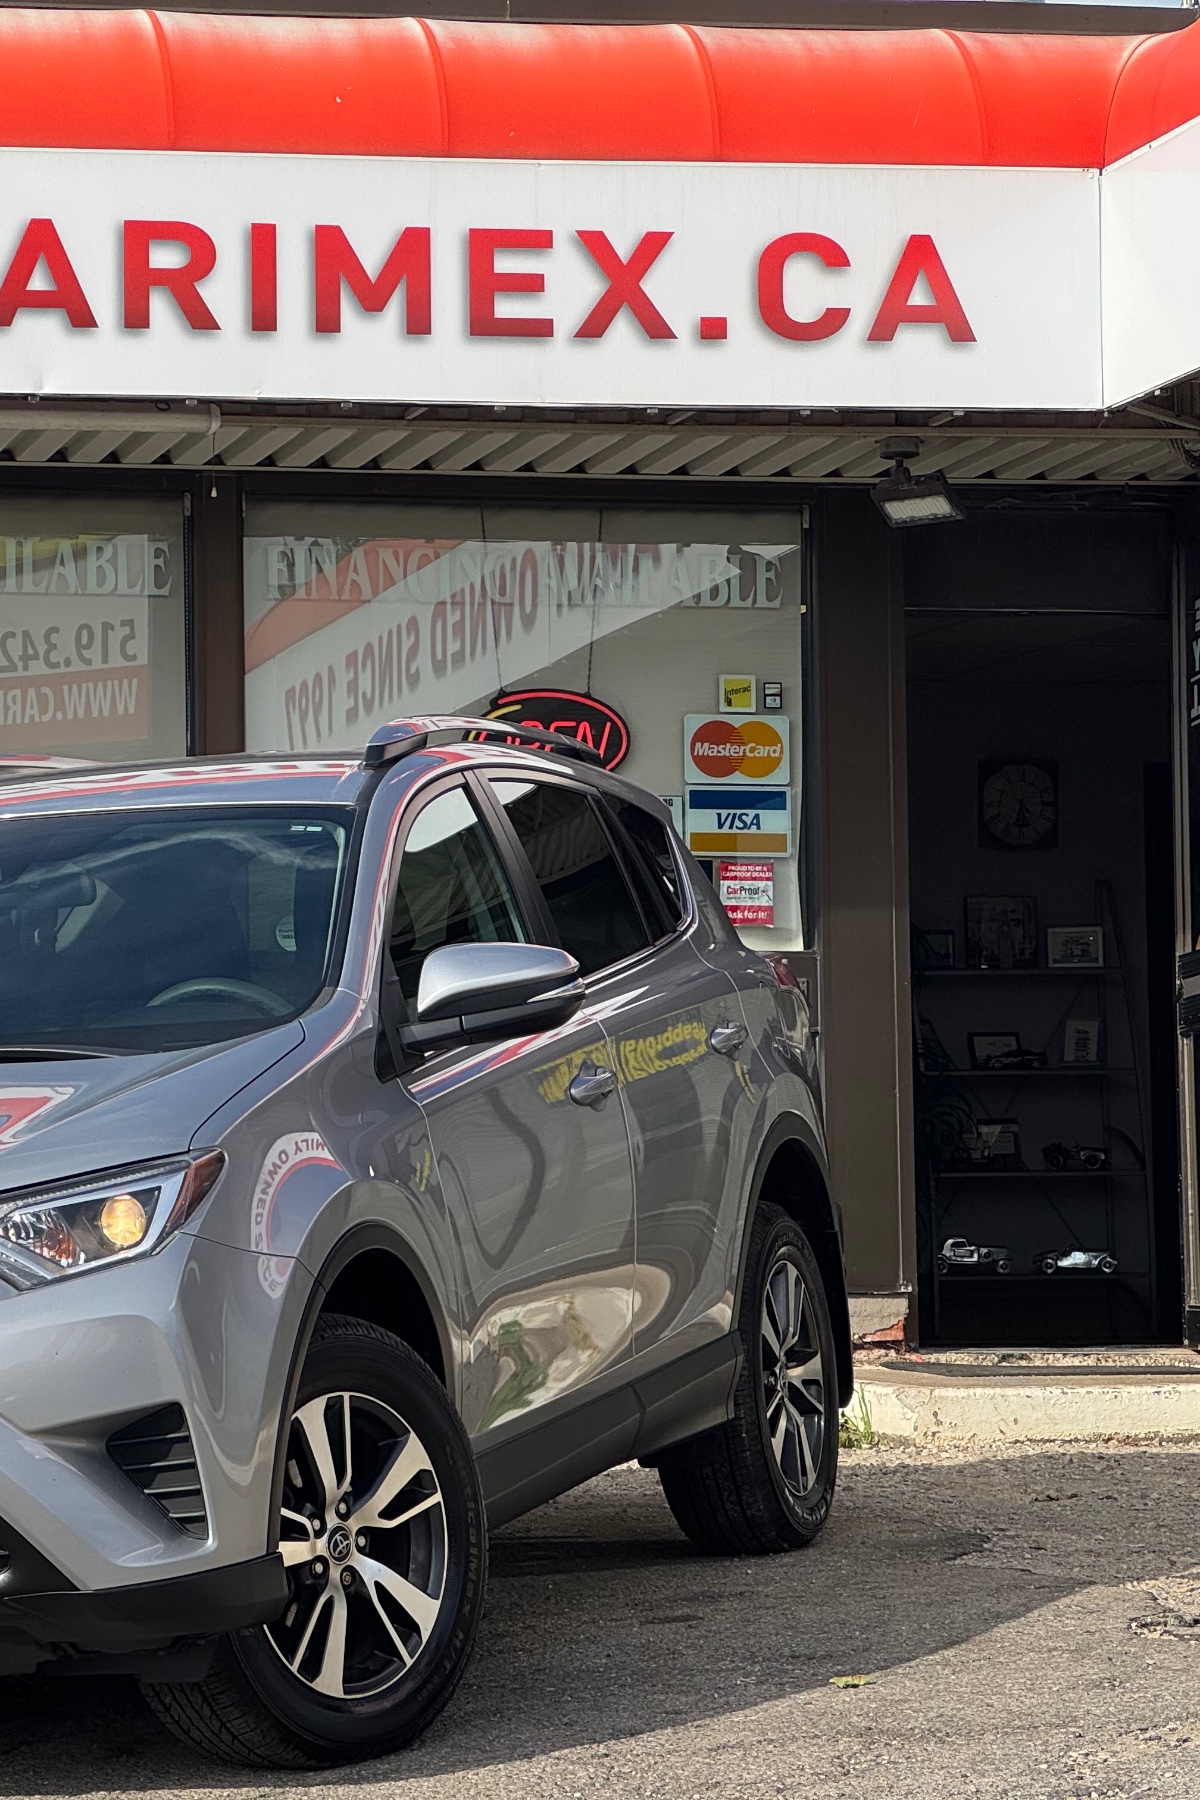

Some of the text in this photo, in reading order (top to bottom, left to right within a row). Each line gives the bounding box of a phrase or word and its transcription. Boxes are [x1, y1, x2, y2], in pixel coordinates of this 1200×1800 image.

[266, 545, 514, 603] FINANCING
[537, 550, 784, 609] AVAILABLE
[693, 741, 781, 758] MasterCard
[715, 812, 762, 831] VISA
[726, 885, 760, 896] CarProof
[744, 910, 757, 919] for
